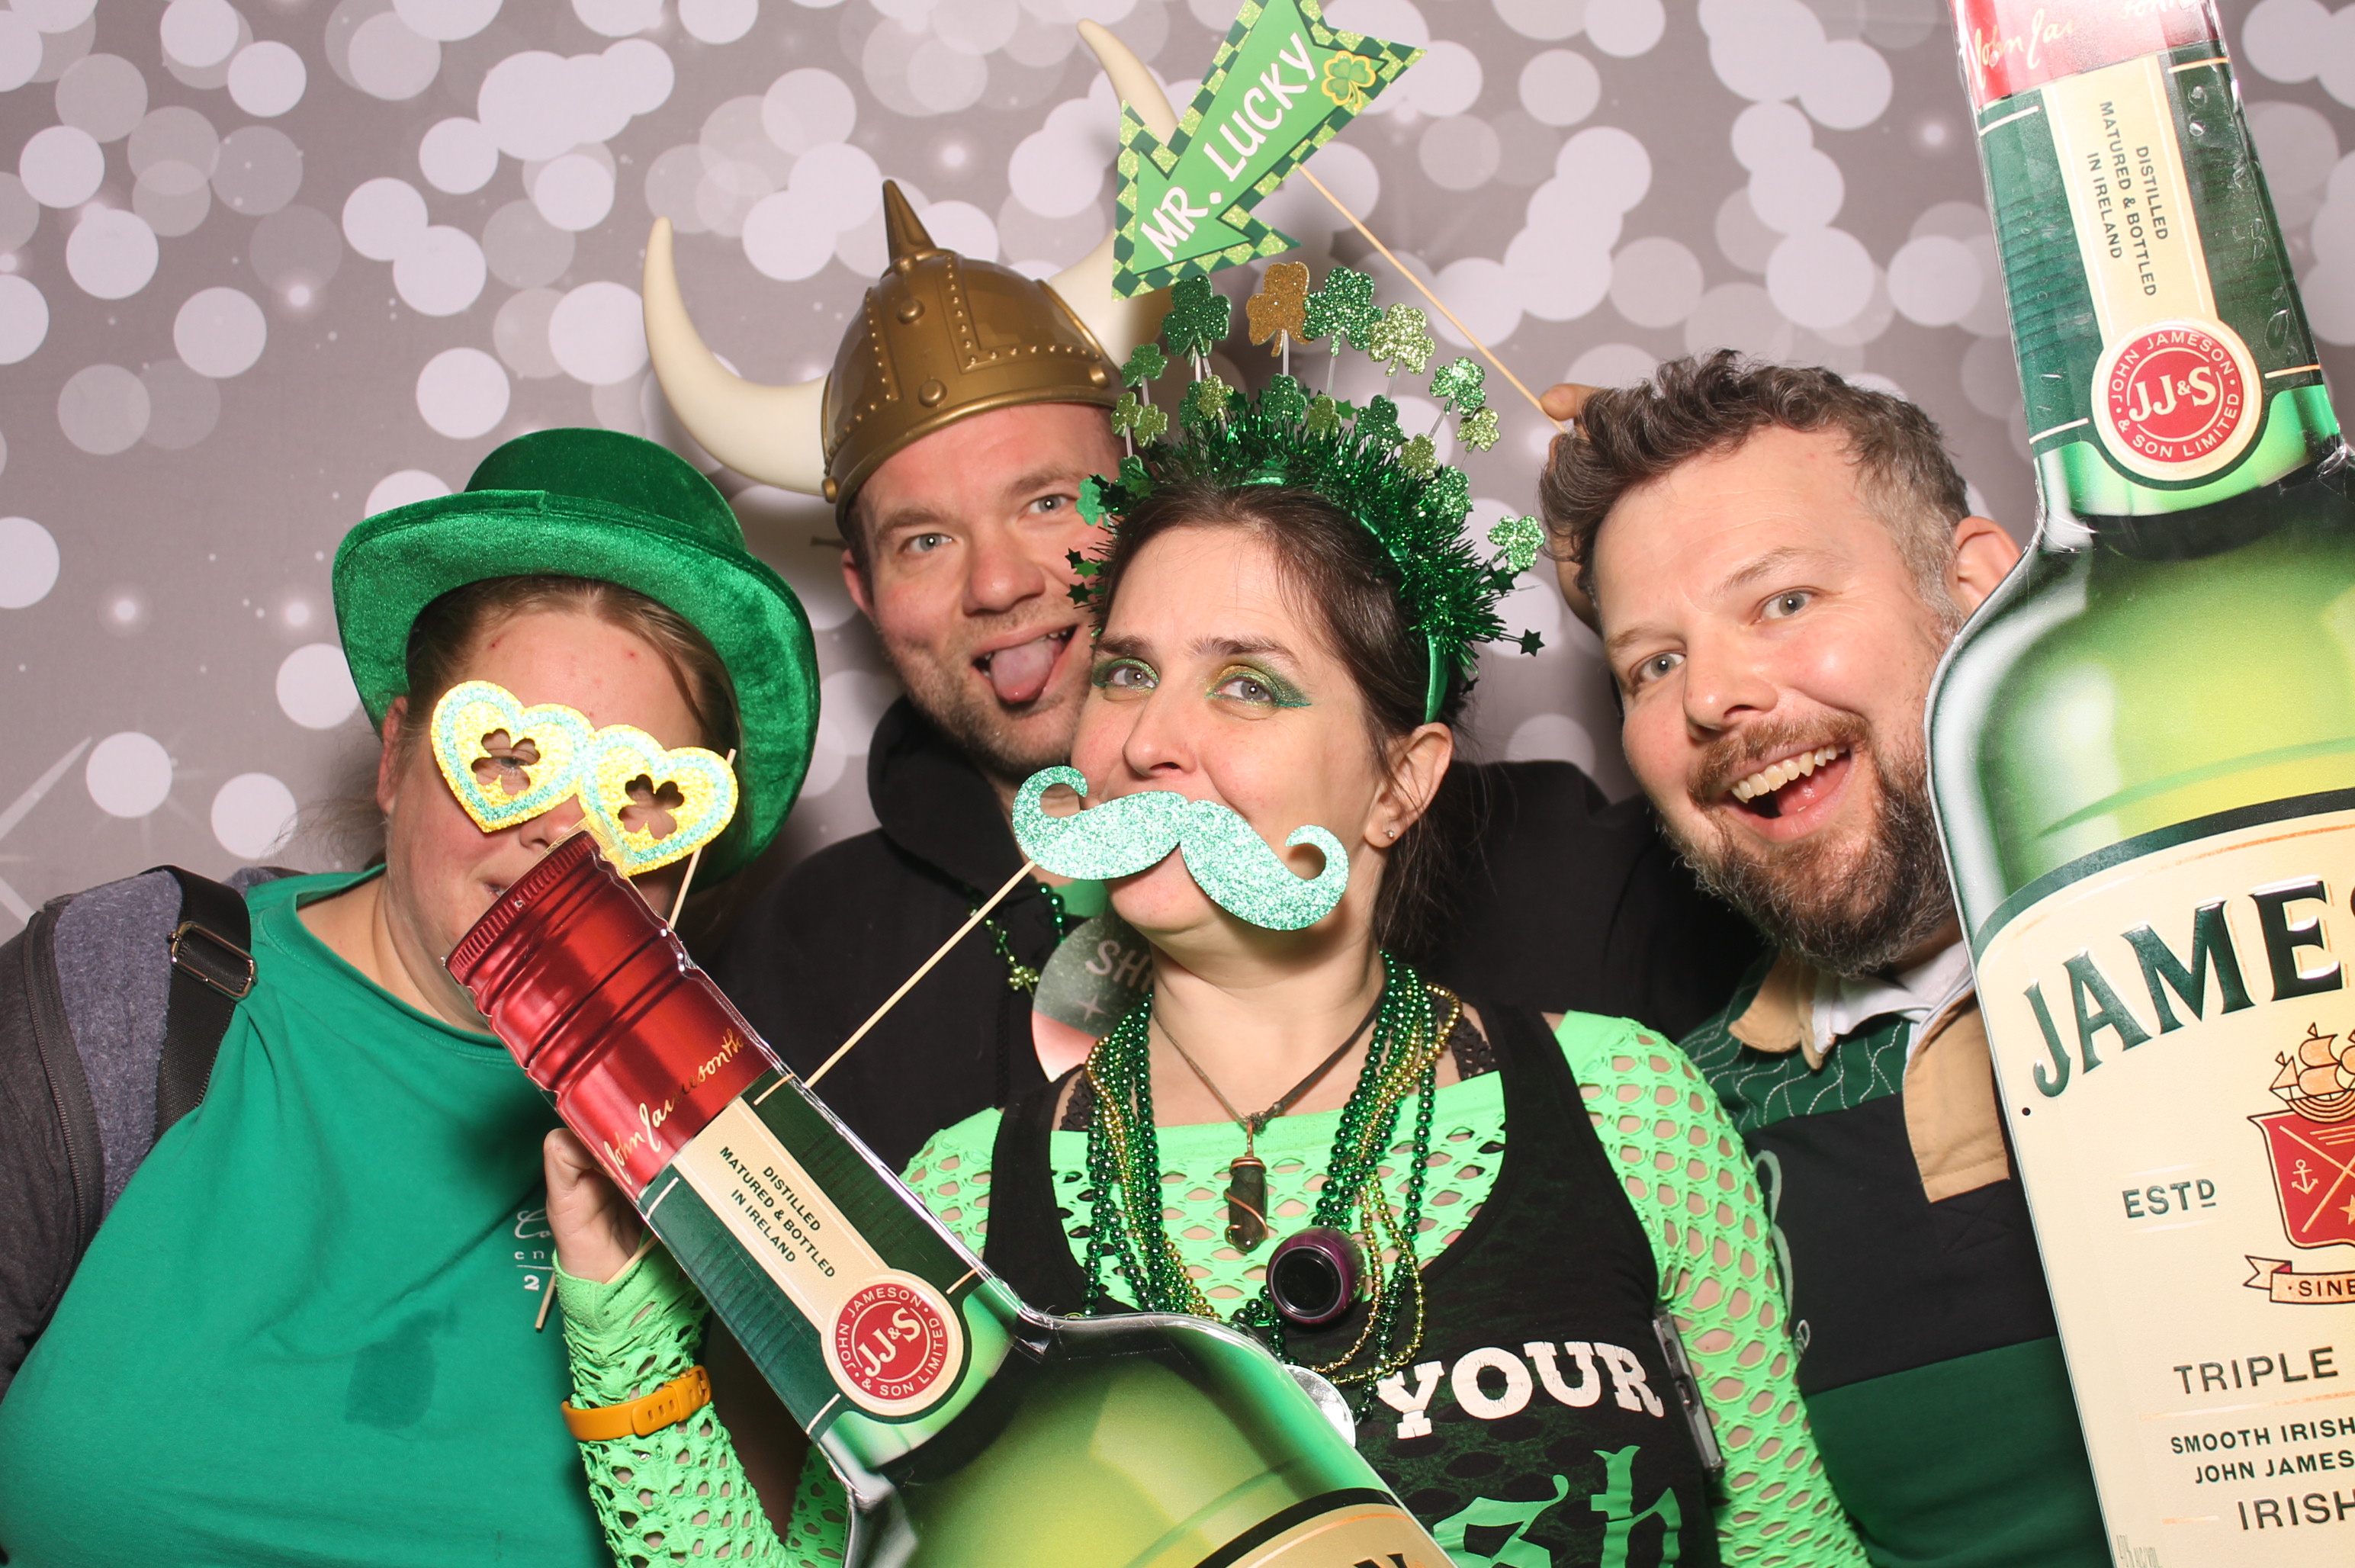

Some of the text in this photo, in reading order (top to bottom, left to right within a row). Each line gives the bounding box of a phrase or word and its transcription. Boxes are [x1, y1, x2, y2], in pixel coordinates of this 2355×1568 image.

[1140, 32, 1316, 262] MR. LUCKY
[2087, 153, 2122, 259] IN IRELAND
[2100, 101, 2157, 296] MATURED & BOTTLED
[2135, 146, 2168, 240] DISTILLED
[2111, 331, 2235, 403] JOHN JAMESON
[2128, 366, 2217, 422] JJ&S
[2118, 393, 2240, 458] & SON LIMITED
[2022, 877, 2355, 1098] JAME
[604, 1131, 644, 1186] John
[720, 1146, 836, 1277] MATURED & BOTTLED
[731, 1189, 796, 1262] IN IRELAND
[763, 1166, 821, 1232] DISTILLED
[2122, 1179, 2217, 1218] ESTD
[837, 1287, 922, 1369] JOHN JAMESON
[858, 1307, 921, 1377] JJ&S
[862, 1318, 944, 1396] & SON LIMITED
[1377, 1341, 1664, 1439] YOUR
[2173, 1346, 2339, 1394] TRIPLE
[2170, 1416, 2355, 1454] SMOOTH IRISH
[2195, 1450, 2355, 1484] JOHN JAMES
[2238, 1488, 2355, 1531] IRISH
